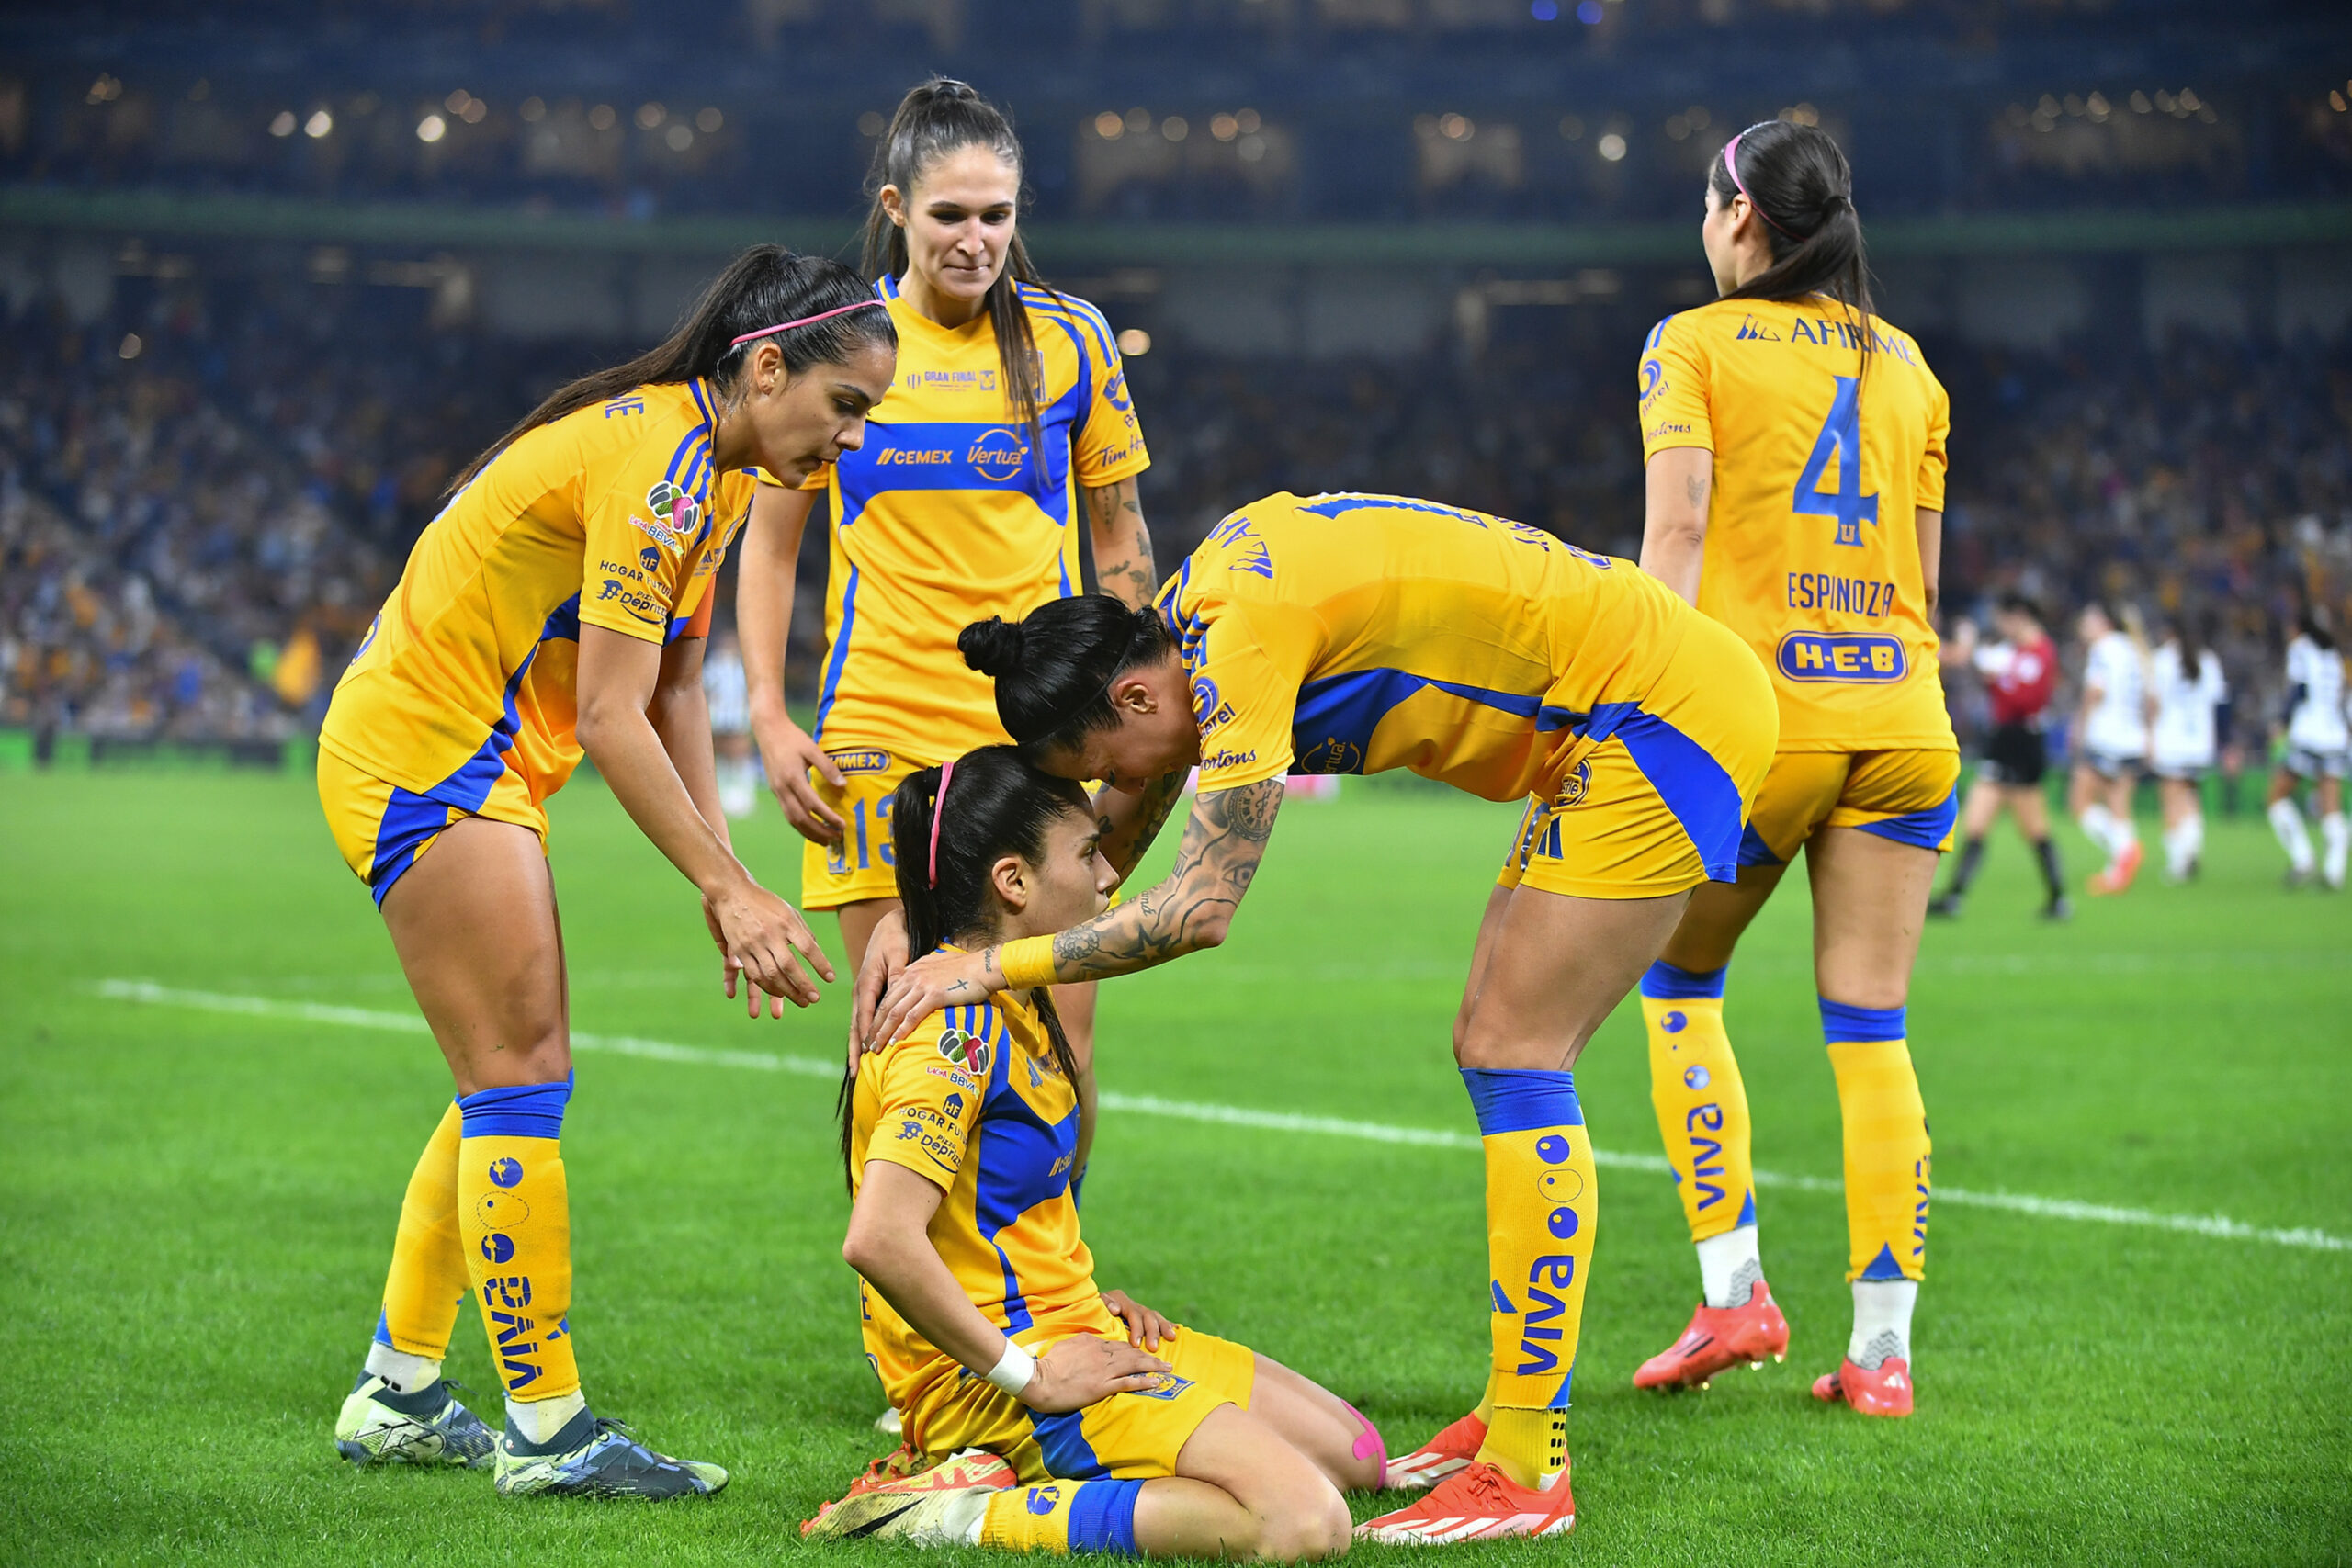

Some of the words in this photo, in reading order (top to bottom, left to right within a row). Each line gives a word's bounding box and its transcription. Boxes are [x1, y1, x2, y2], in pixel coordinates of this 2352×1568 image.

[1791, 317, 1917, 367] AFIRME
[893, 450, 953, 465] CEMEX
[967, 445, 1023, 465] Vertua
[1099, 444, 1127, 467] Tim
[1792, 375, 1880, 547] 4
[648, 525, 675, 549] BBVA
[599, 560, 644, 582] HOGAR
[640, 554, 658, 570] HF
[1788, 572, 1895, 617] ESPINOZA
[1794, 642, 1895, 673] H-E-B
[1202, 702, 1237, 738] erel
[1201, 748, 1257, 771] ortons
[950, 1072, 976, 1093] BBVA
[899, 1106, 945, 1129] HOGAR
[943, 1100, 960, 1116] HF
